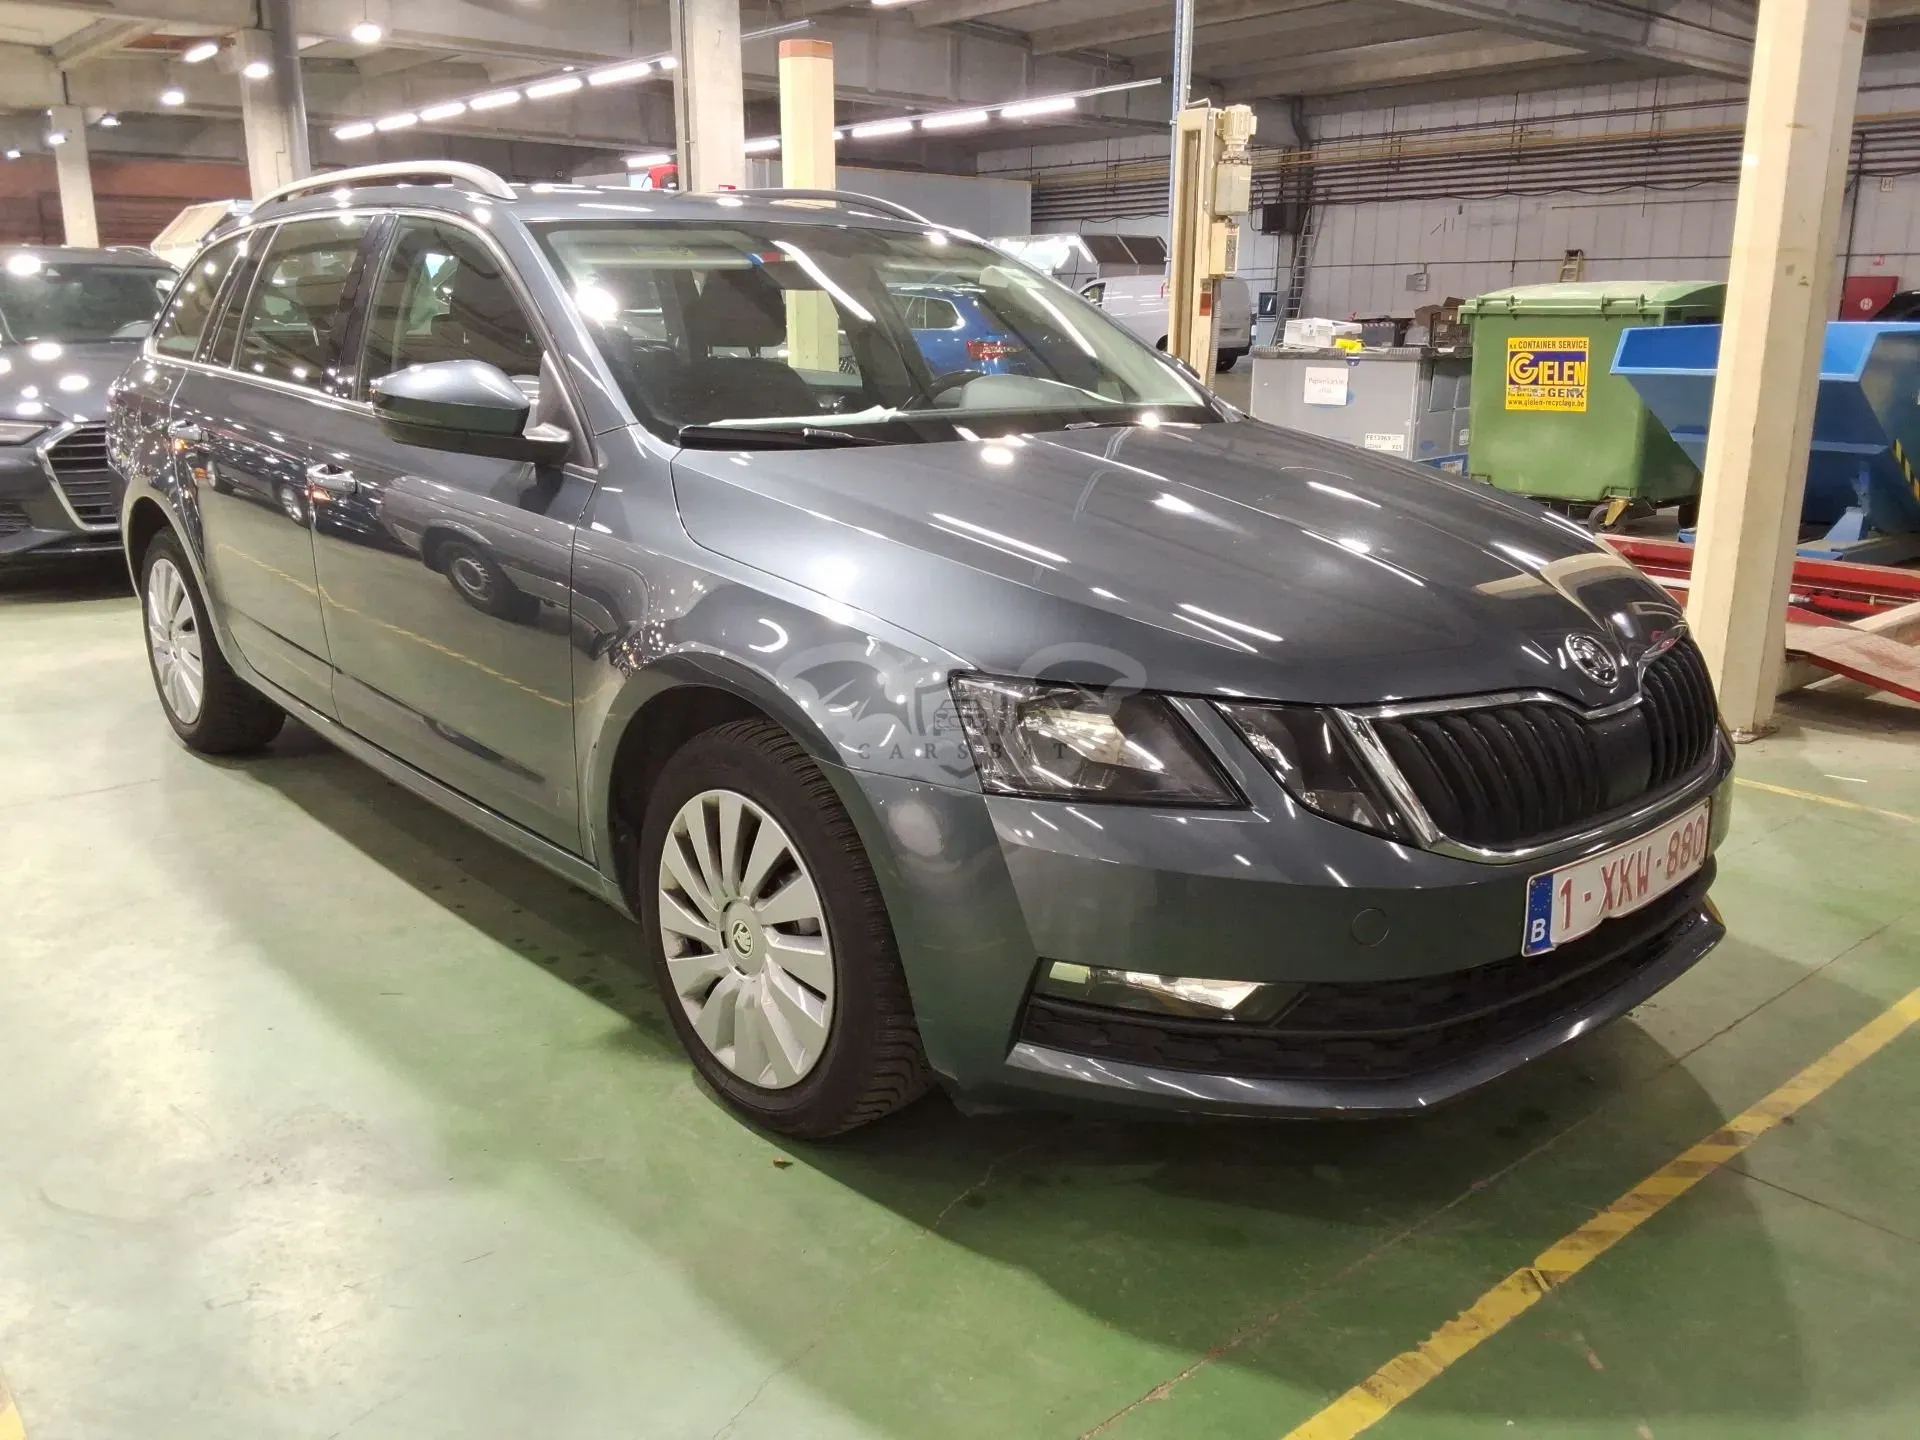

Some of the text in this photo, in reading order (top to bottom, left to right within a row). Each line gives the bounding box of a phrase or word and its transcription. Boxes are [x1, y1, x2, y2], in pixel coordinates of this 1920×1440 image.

[1518, 340, 1557, 350] CONTAINER
[1558, 340, 1588, 349] SERVICE
[1509, 352, 1586, 385] GIELEN
[1547, 388, 1585, 398] GENK
[1558, 814, 1707, 931] 1-XKW-880
[1530, 918, 1546, 943] B
